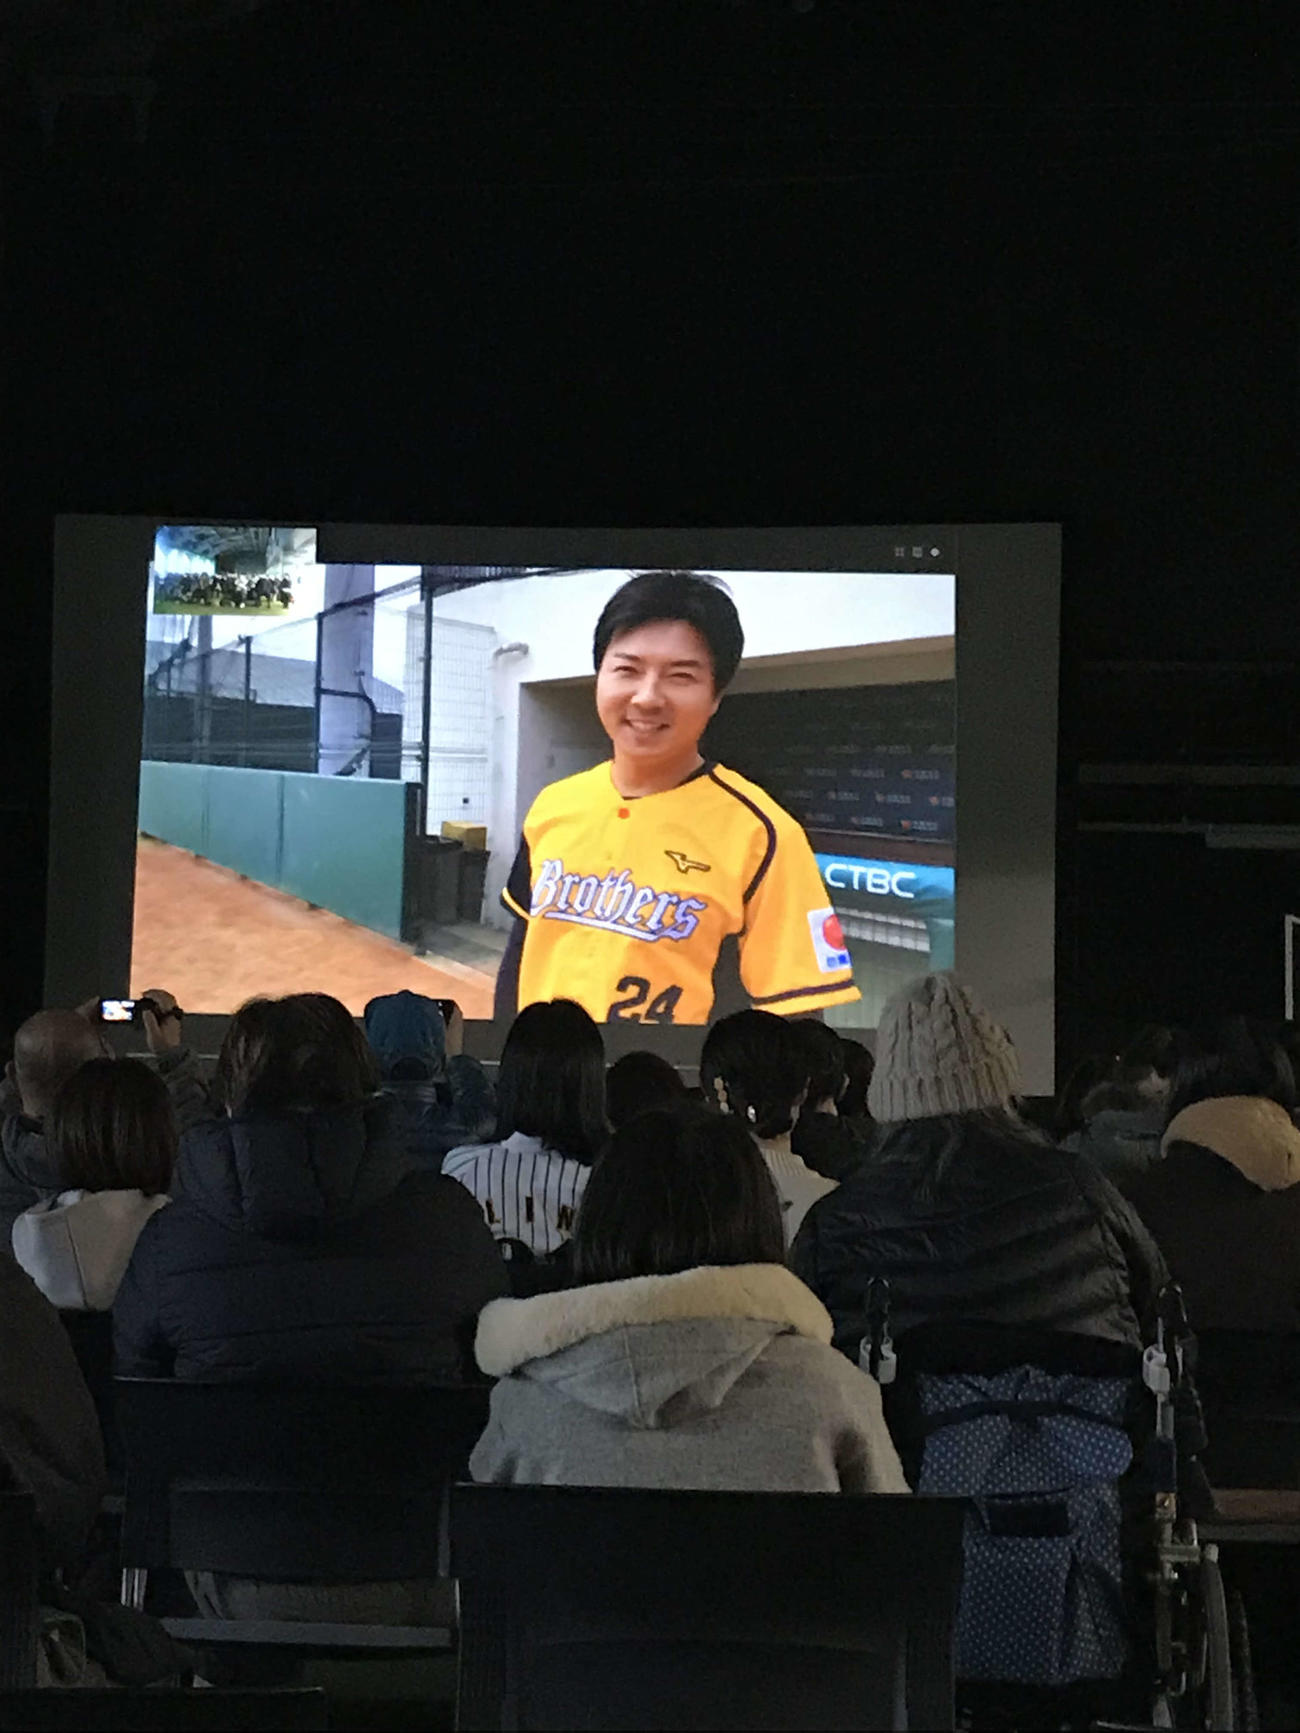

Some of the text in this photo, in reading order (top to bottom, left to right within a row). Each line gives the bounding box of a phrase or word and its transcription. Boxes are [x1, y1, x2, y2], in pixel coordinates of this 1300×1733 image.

[530, 859, 708, 942] Brothers
[824, 862, 916, 899] CTBC
[609, 975, 683, 1024] 24
